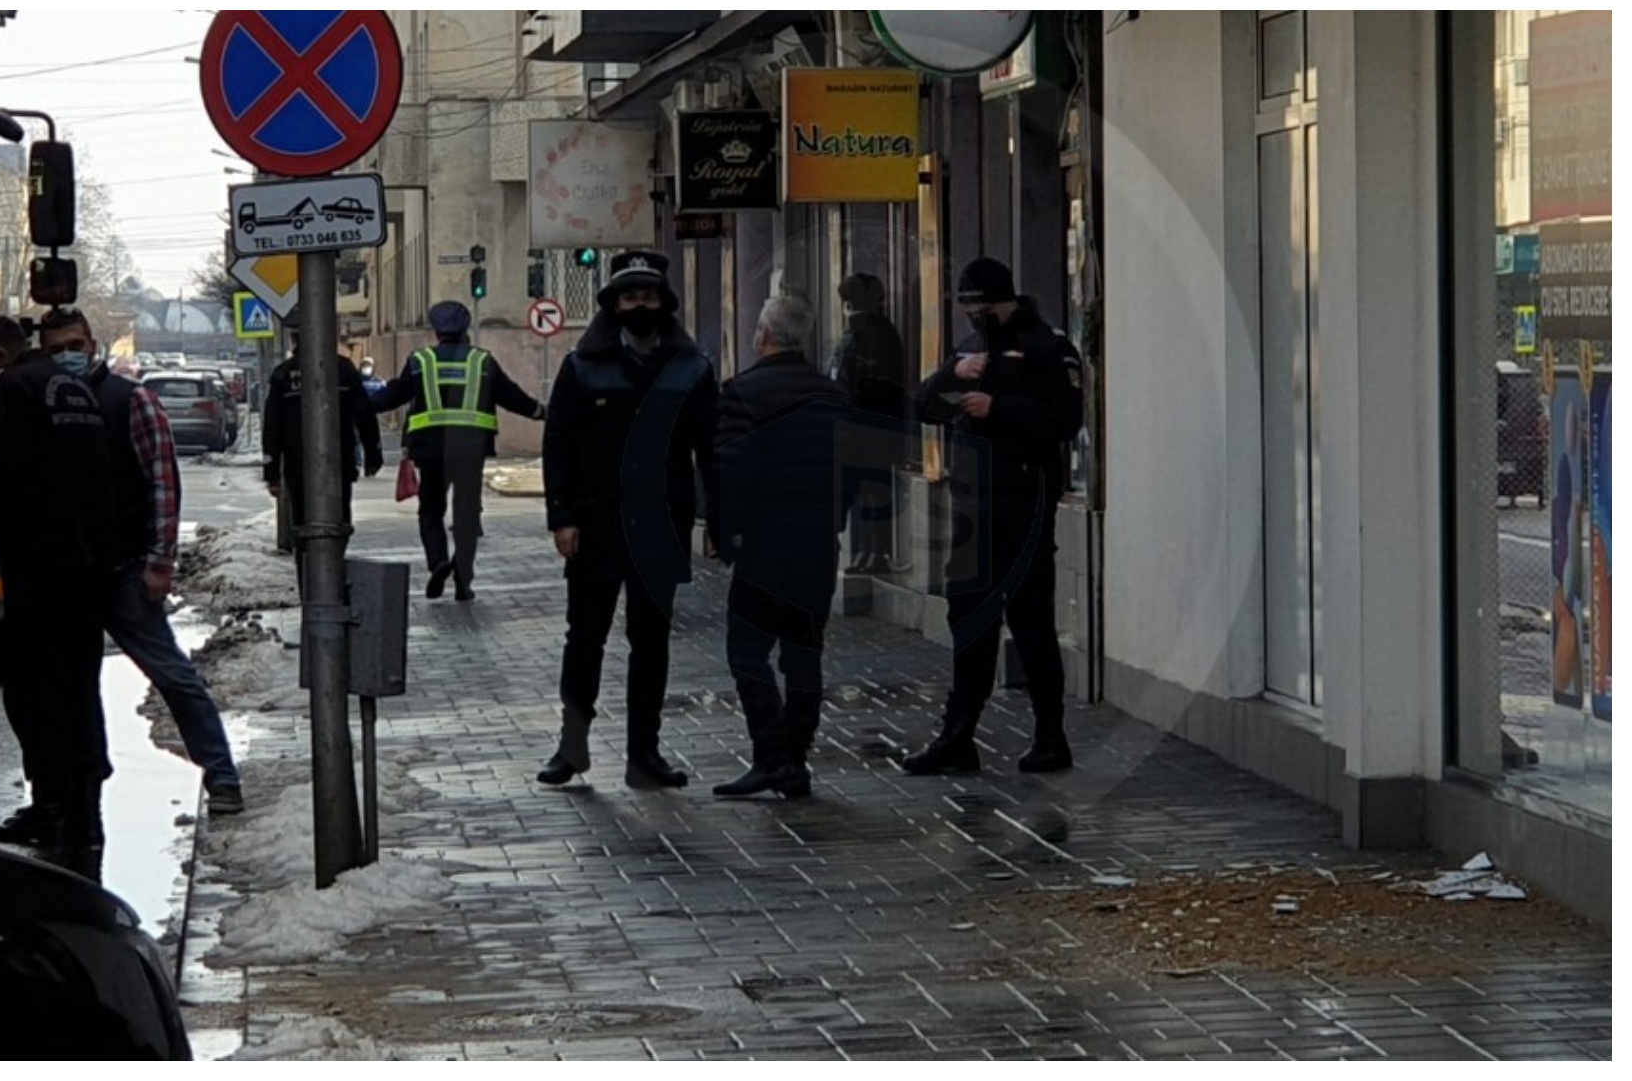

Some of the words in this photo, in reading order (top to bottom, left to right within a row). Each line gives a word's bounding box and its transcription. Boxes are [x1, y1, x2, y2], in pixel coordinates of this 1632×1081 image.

[791, 123, 913, 157] Natura
[688, 159, 767, 185] Royal
[286, 233, 315, 247] 0733
